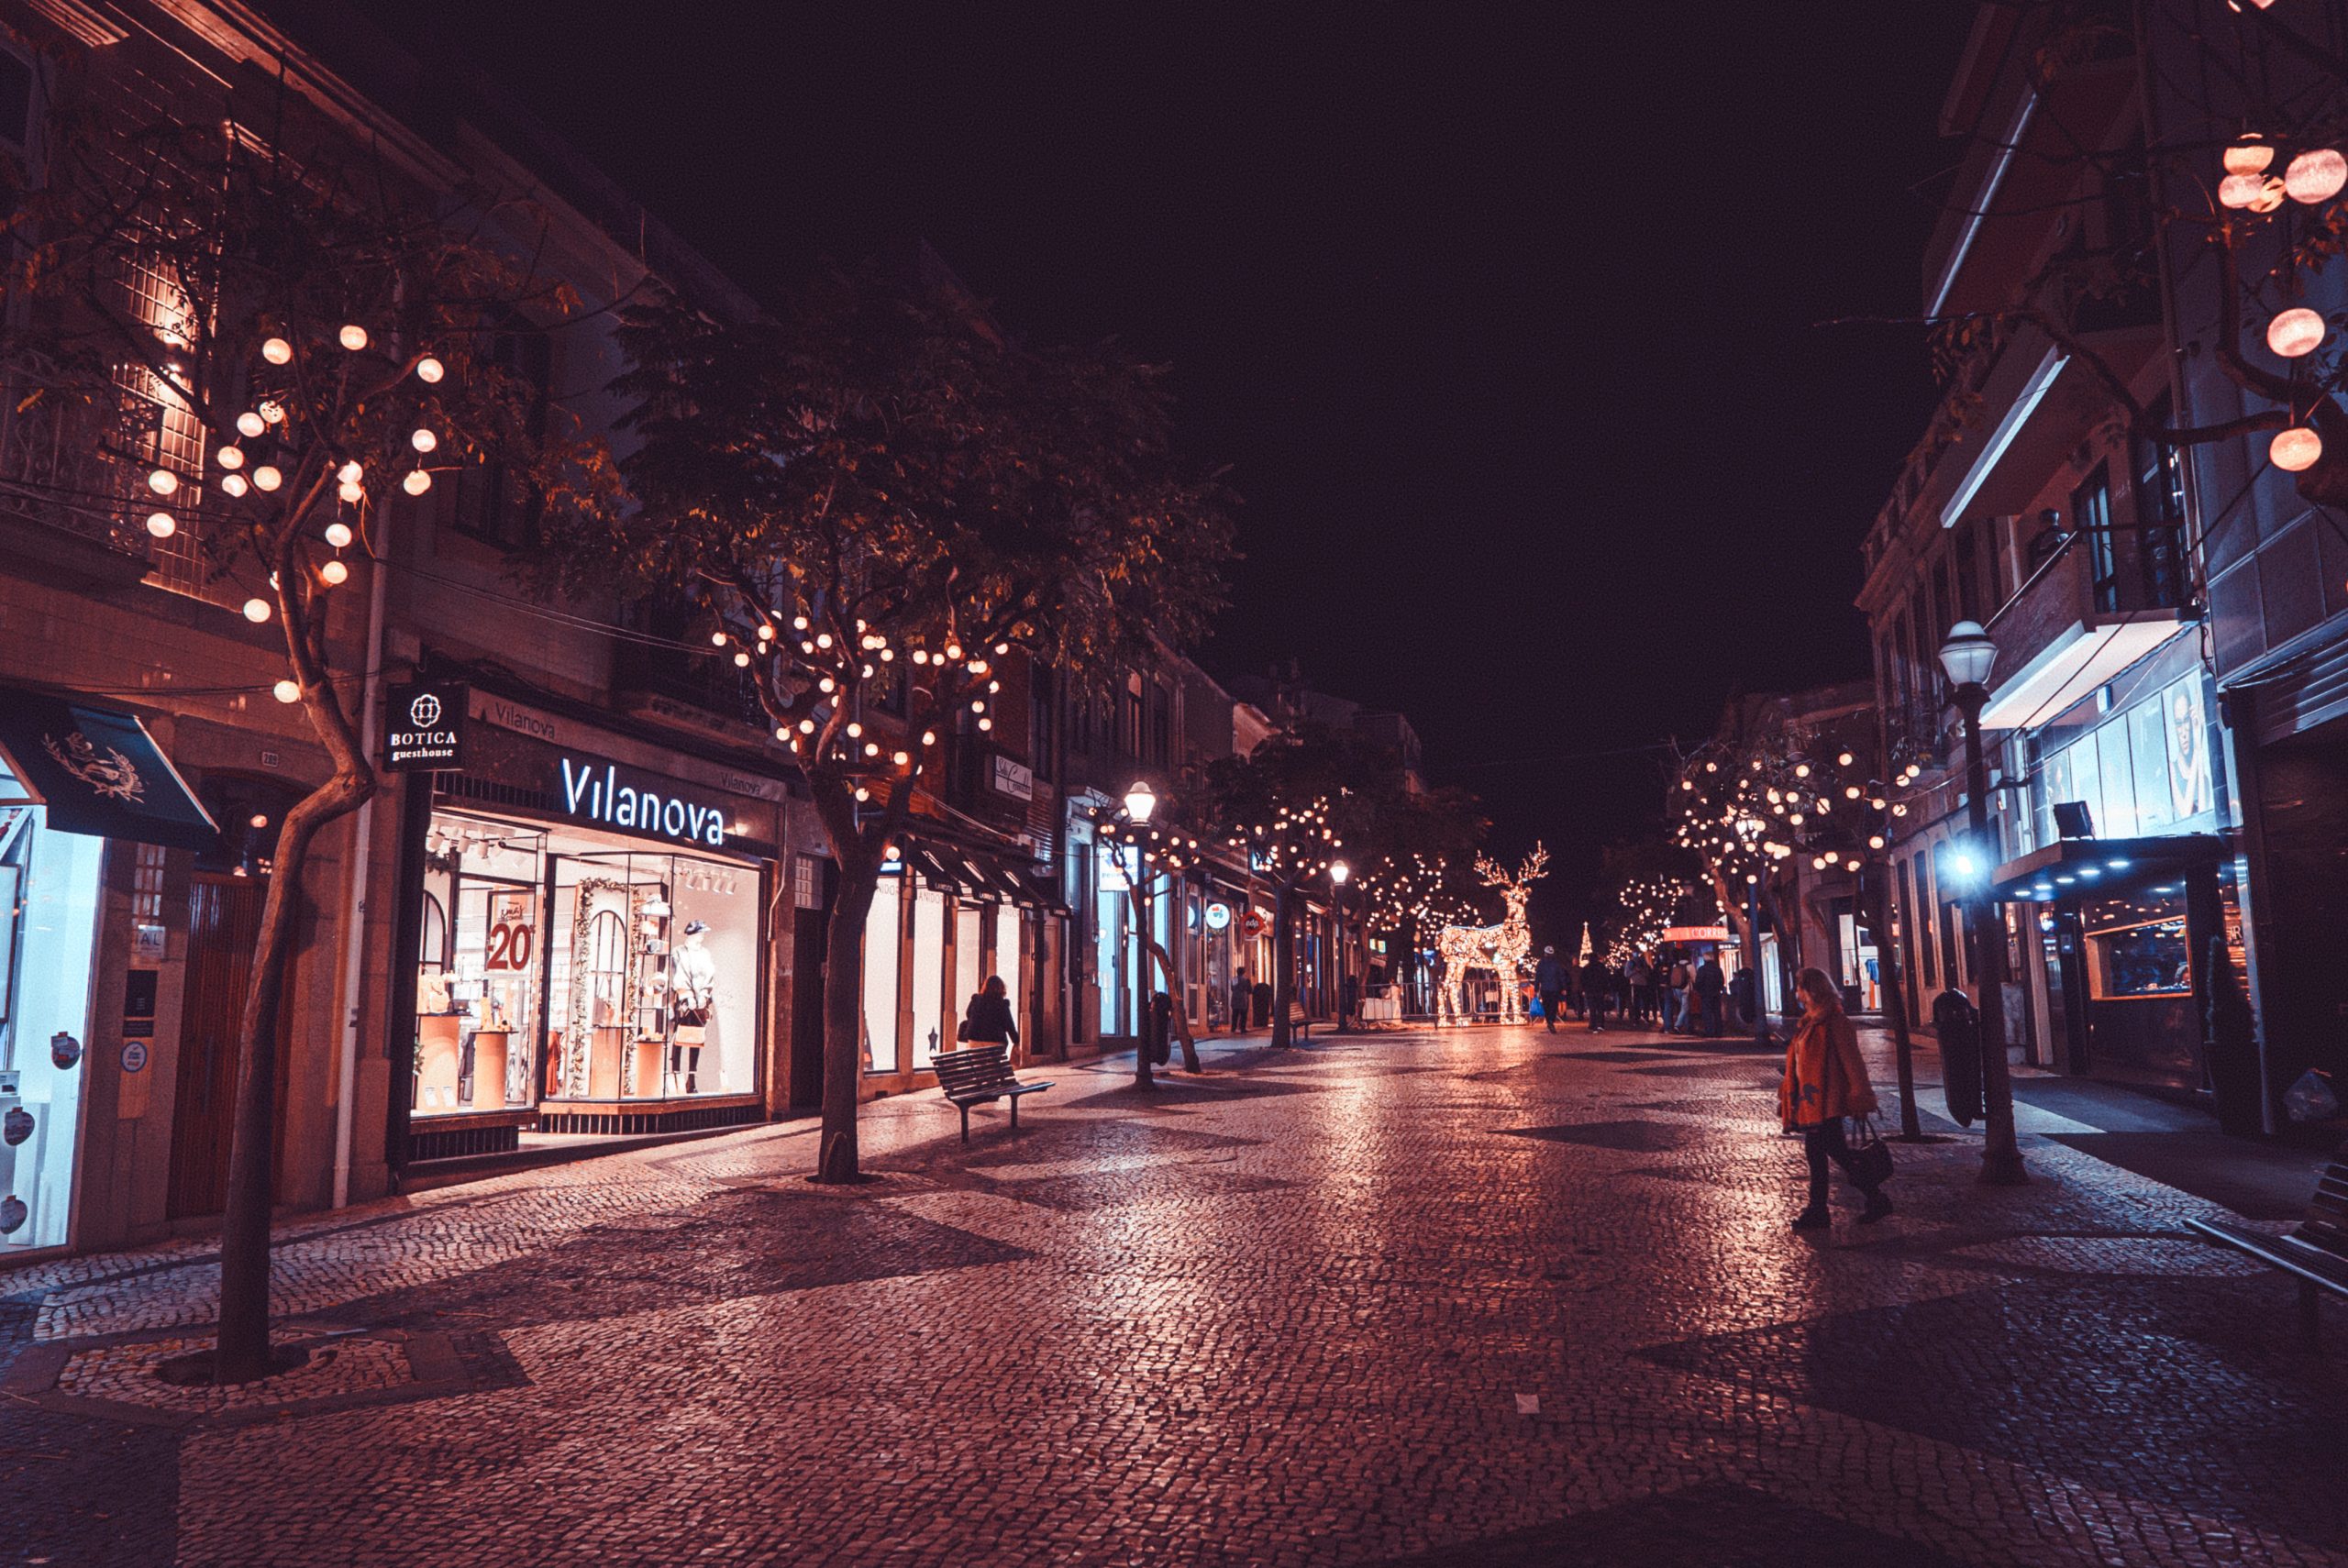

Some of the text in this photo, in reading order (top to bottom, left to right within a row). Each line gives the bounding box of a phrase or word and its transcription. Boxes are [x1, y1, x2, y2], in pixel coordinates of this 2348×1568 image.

[495, 702, 555, 739] Vilanova
[391, 732, 457, 745] BOTICA
[393, 747, 453, 761] guesthouse
[561, 757, 724, 845] Vilanova
